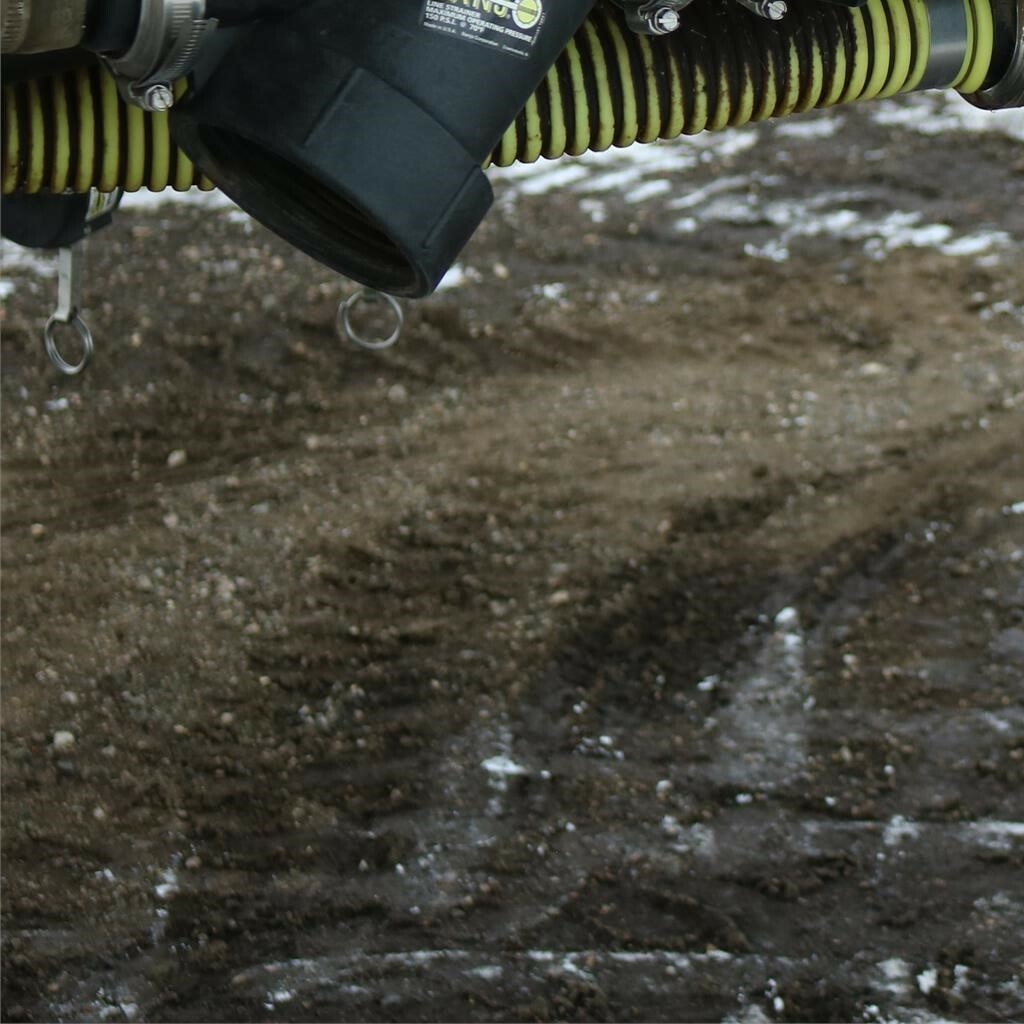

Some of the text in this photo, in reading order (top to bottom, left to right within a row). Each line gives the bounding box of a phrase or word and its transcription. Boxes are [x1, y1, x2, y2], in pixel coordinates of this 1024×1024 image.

[425, 12, 439, 21] 150
[426, 0, 481, 19] LINE STRAINER
[425, 6, 466, 21] MAXIMUM
[466, 16, 505, 33] OPERATING
[504, 27, 533, 43] PRESSURE
